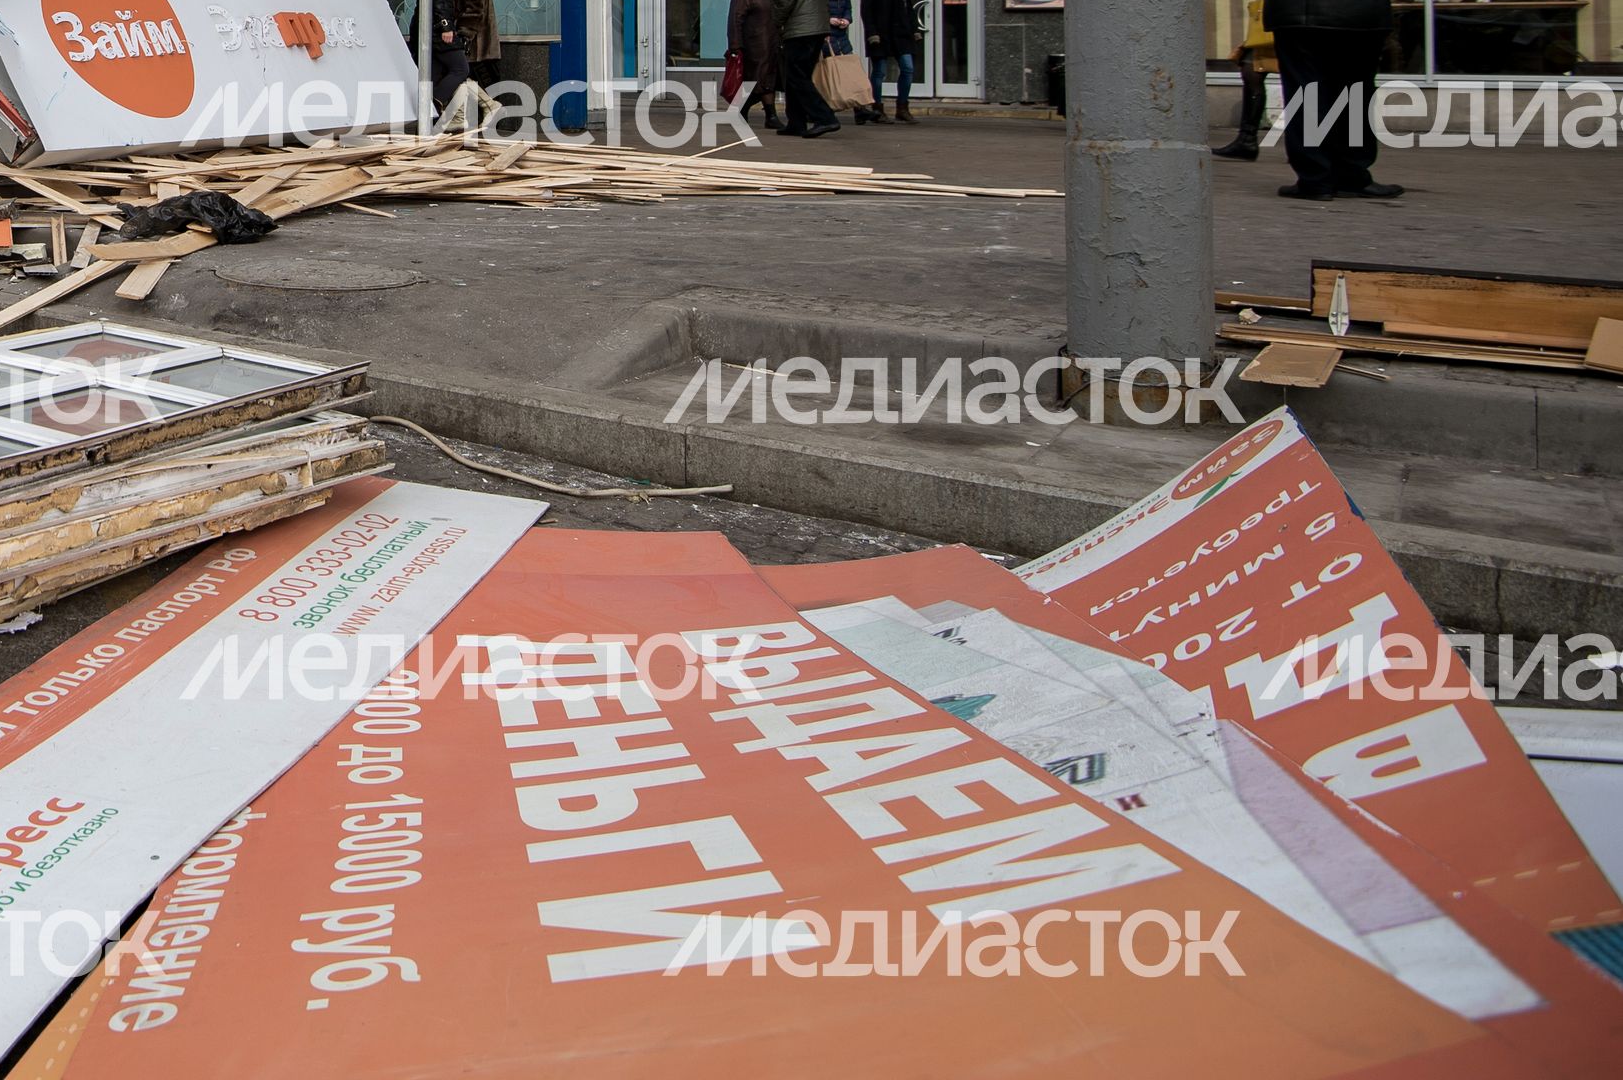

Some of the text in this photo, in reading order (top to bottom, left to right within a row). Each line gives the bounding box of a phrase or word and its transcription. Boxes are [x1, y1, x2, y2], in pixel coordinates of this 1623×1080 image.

[51, 10, 186, 62] Займ
[1178, 423, 1275, 494] Займ
[238, 513, 400, 622] 8 800 333-02-02
[293, 519, 432, 629] звонок бесплатный
[1089, 479, 1322, 617] Требуется
[1303, 512, 1338, 542] 5
[3, 643, 125, 715] только
[116, 571, 226, 643] паспорт
[216, 547, 258, 573] РФ
[337, 743, 404, 785] до
[456, 634, 821, 983] ДЕНЬГИ
[678, 621, 1182, 926] ВЫДАЕМ
[11, 880, 31, 896] и
[21, 806, 120, 880] безотказно
[330, 793, 424, 895] 15000
[290, 903, 421, 1011] руб.
